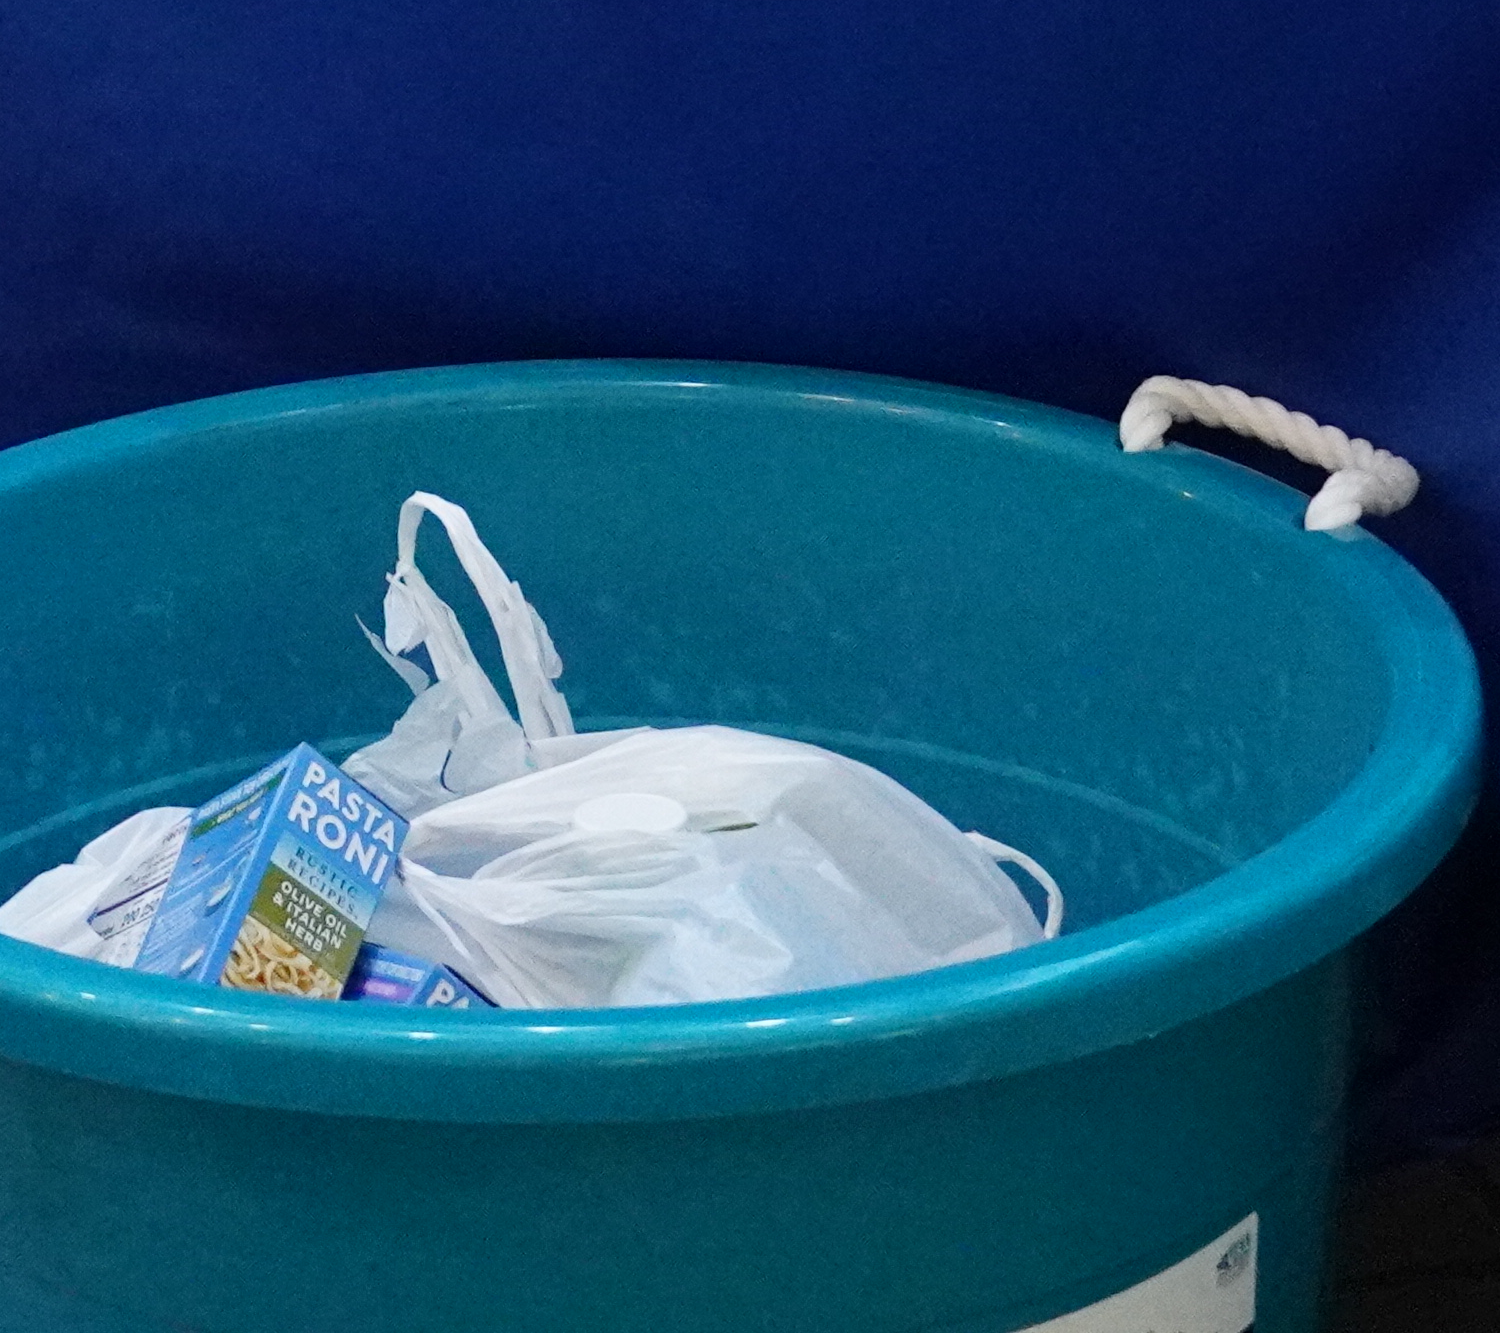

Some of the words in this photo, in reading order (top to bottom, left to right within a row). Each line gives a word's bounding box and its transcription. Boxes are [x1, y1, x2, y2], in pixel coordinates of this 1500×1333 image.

[302, 761, 396, 851] PASTA
[288, 792, 390, 885] RONI
[281, 882, 323, 922] OLIVE
[325, 911, 347, 937] OIL
[286, 900, 343, 950] ITALIAN
[286, 920, 325, 953] HERB
